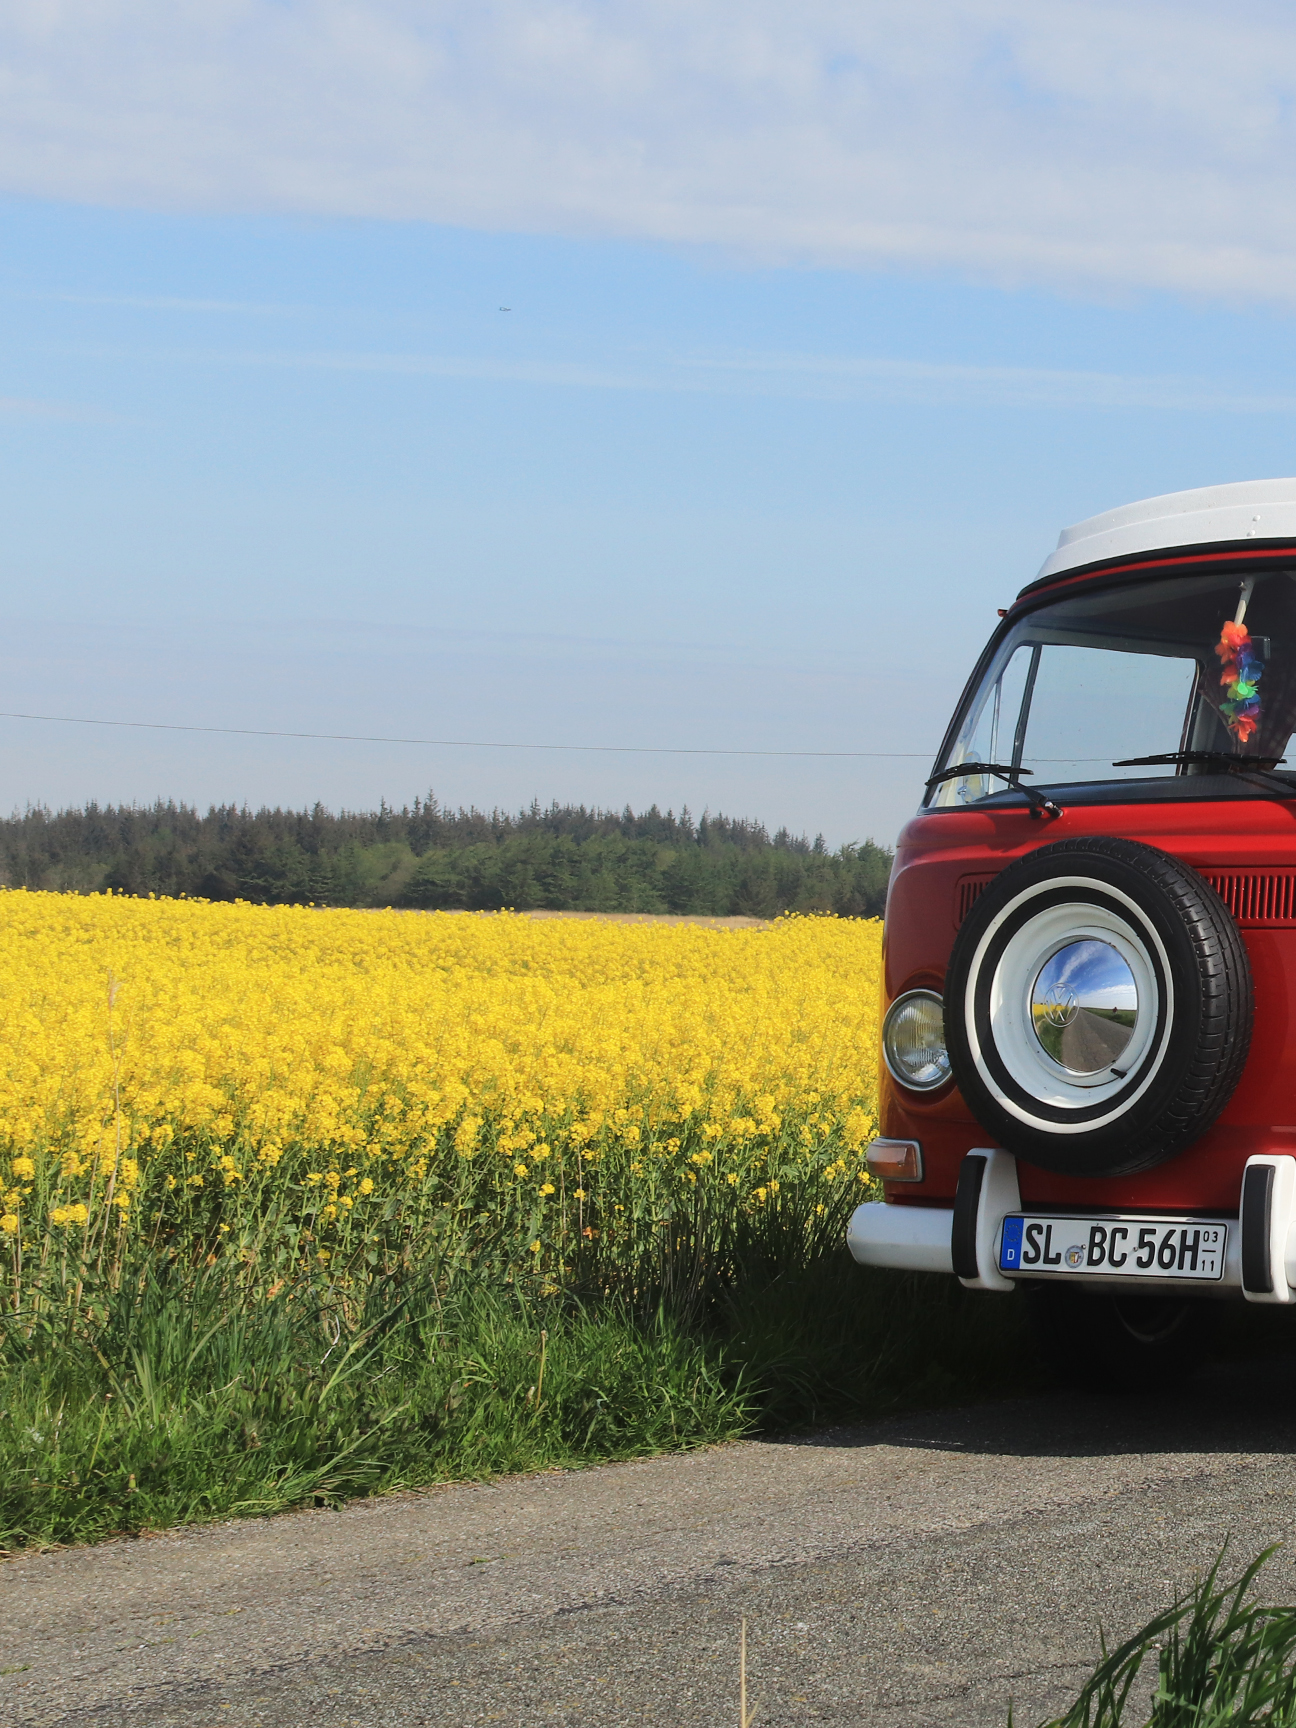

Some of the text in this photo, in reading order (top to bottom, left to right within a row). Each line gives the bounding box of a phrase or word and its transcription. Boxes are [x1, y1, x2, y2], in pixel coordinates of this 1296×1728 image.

[1202, 1230, 1219, 1243] 03
[1022, 1223, 1062, 1265] SL
[1086, 1225, 1129, 1268] BC
[1136, 1227, 1201, 1271] 56H
[1007, 1248, 1015, 1261] D
[1201, 1259, 1215, 1272] 11
